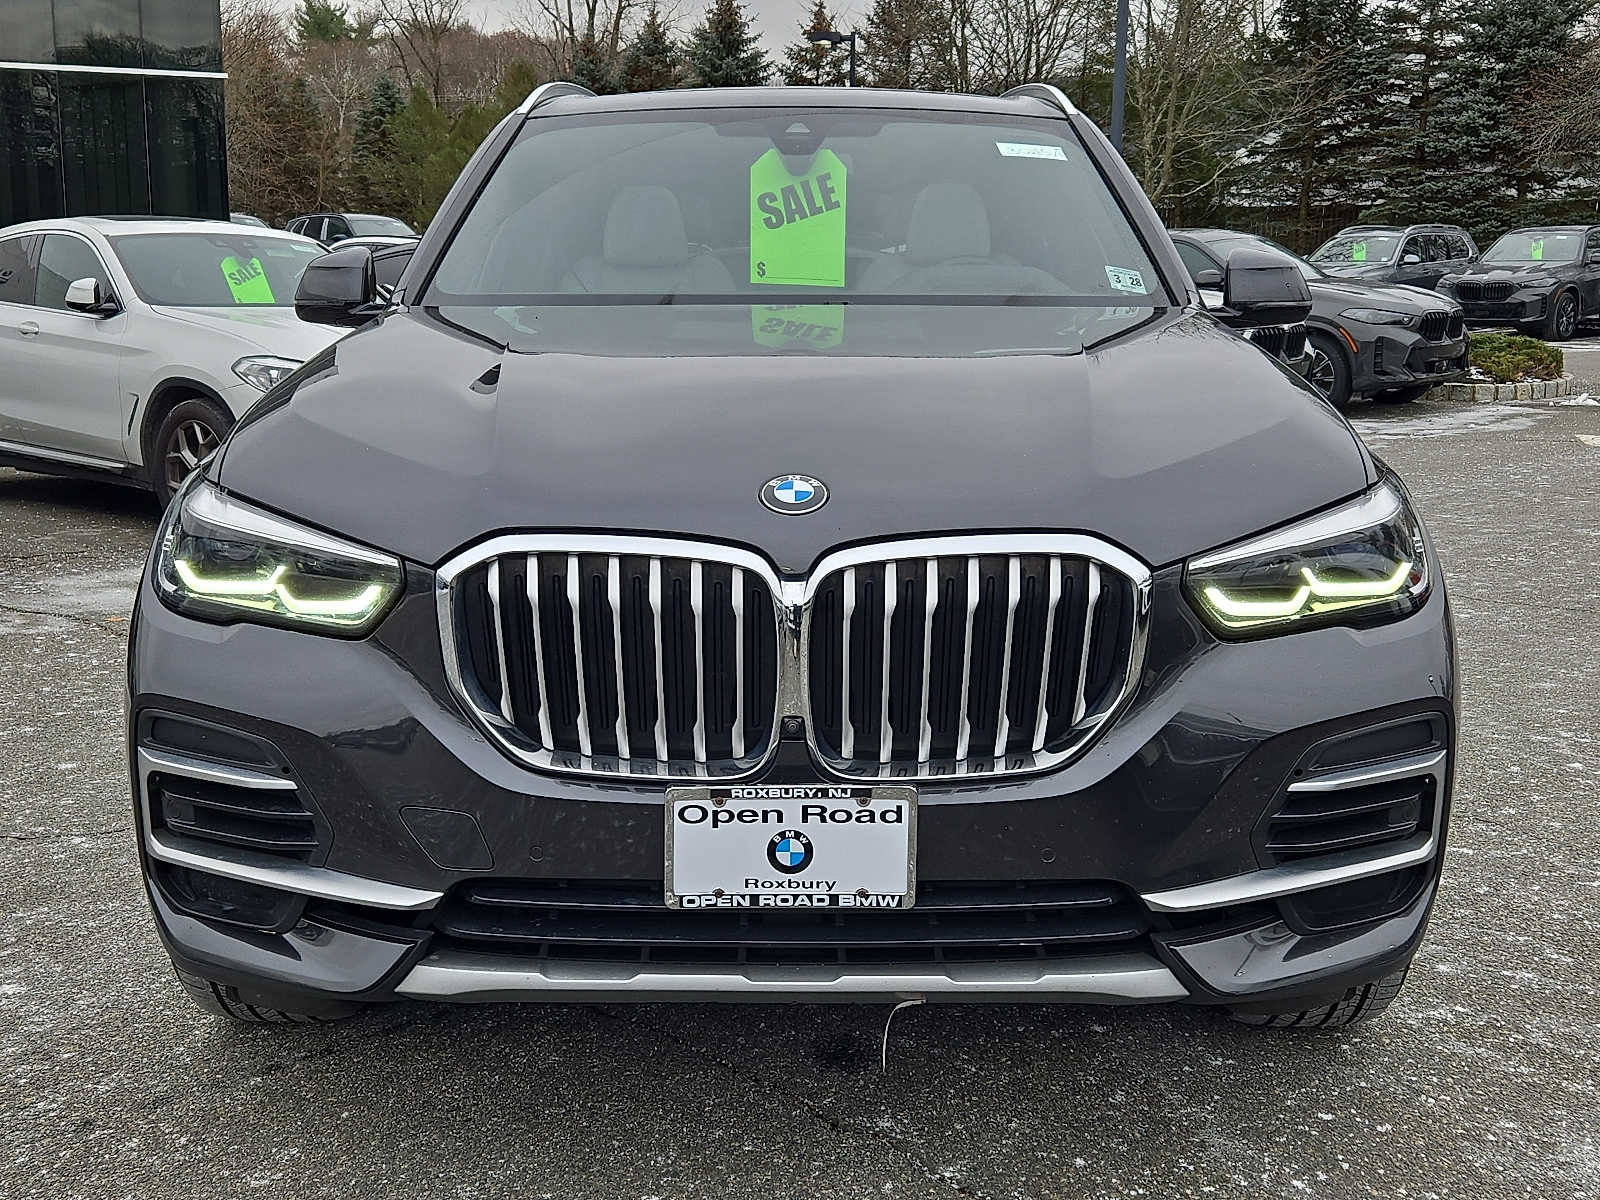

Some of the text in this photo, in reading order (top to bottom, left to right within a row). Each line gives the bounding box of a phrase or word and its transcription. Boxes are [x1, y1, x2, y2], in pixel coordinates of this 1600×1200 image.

[757, 172, 840, 230] SALE
[228, 262, 262, 286] SALE
[757, 261, 766, 278] $
[1113, 274, 1143, 287] 3 28
[730, 788, 851, 799] ROXBURY, NJ
[677, 804, 904, 829] Open Road
[772, 830, 809, 844] BMW
[744, 878, 837, 892] Roxbury
[682, 894, 900, 909] OPEN ROAD BMW
